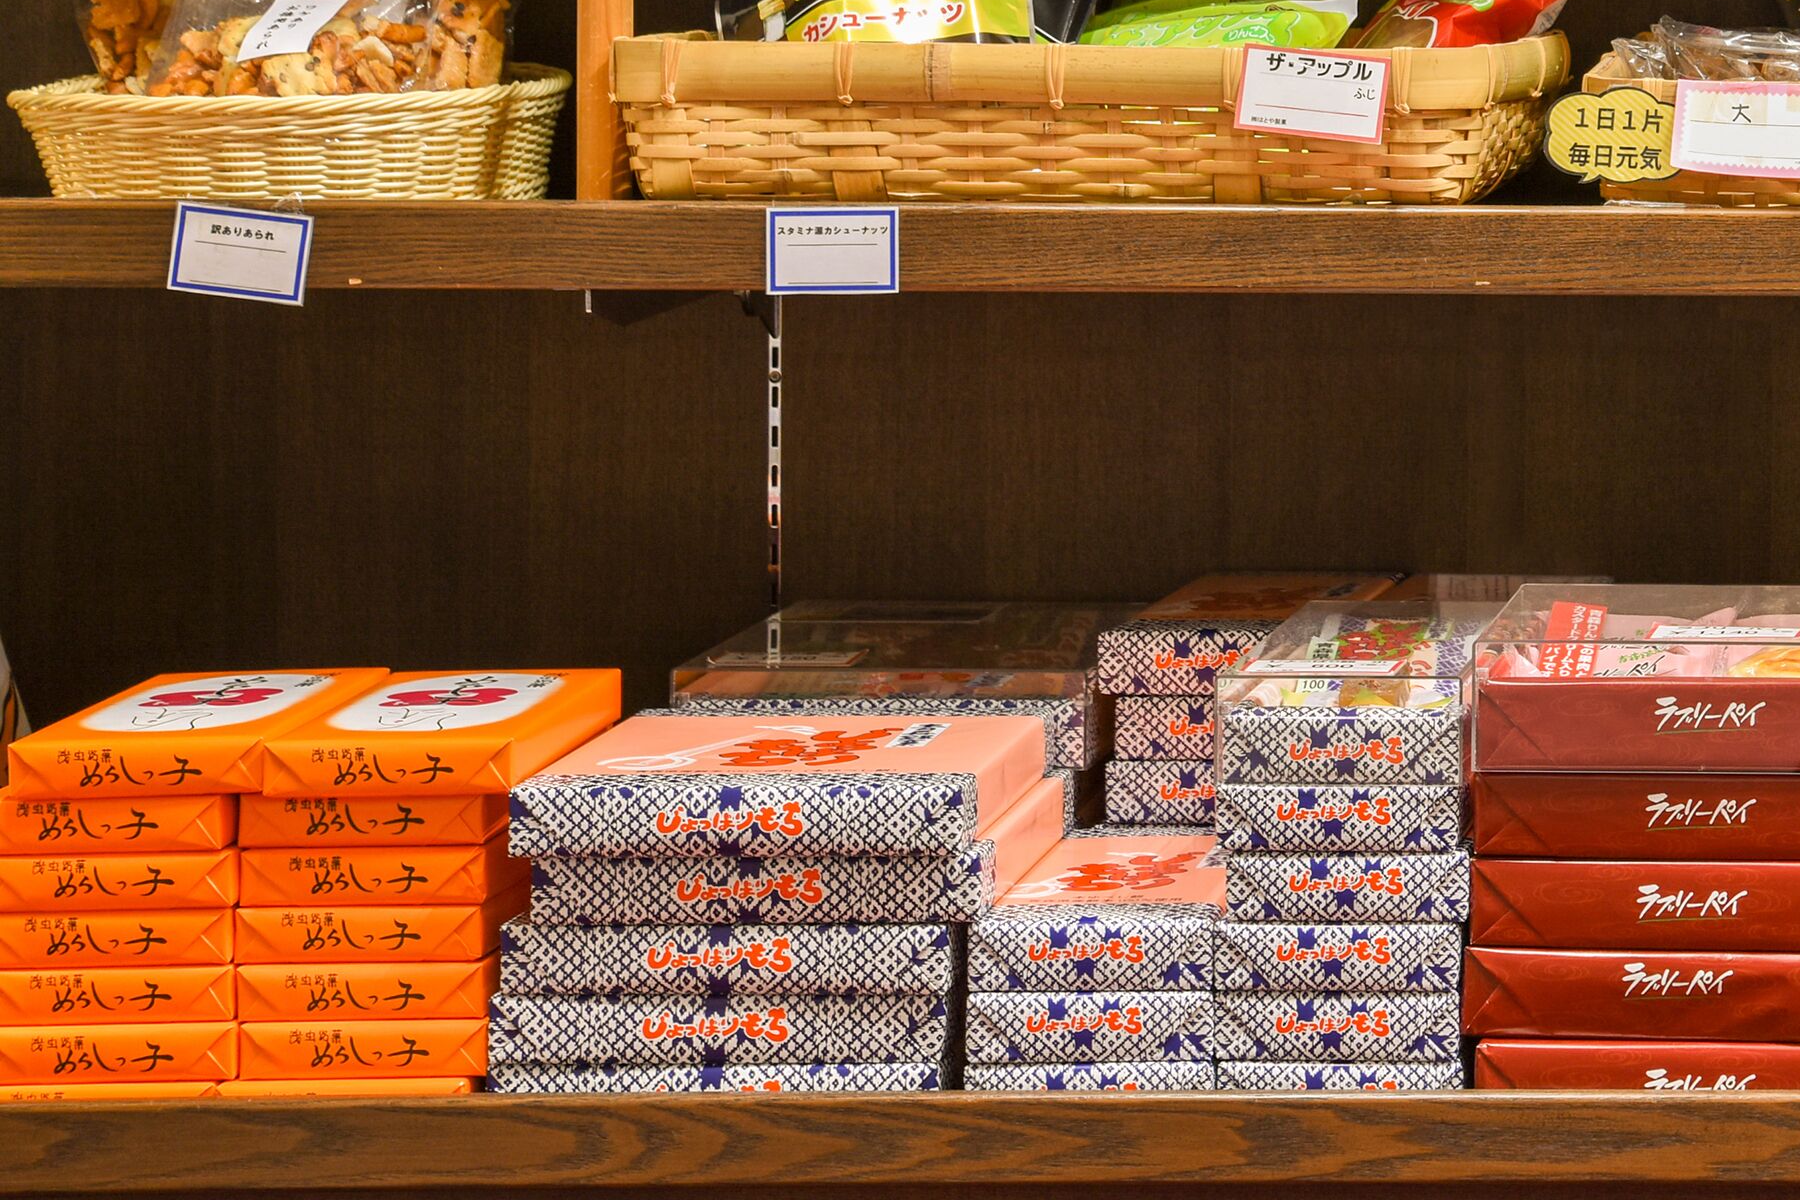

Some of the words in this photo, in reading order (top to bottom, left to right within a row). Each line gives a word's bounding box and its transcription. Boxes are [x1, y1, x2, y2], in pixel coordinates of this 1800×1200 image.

[1266, 52, 1373, 81] ザ・アップル
[1353, 87, 1377, 102] ふじ
[1574, 107, 1664, 135] 1日1片
[1731, 103, 1752, 124] 大
[1567, 143, 1663, 171] 毎日元気
[211, 224, 275, 242] 訳ありあられ
[1653, 695, 1768, 730] ラブリーパイ
[1636, 884, 1749, 919] ラブリーパイ
[1621, 962, 1735, 997] ラブリーパイ
